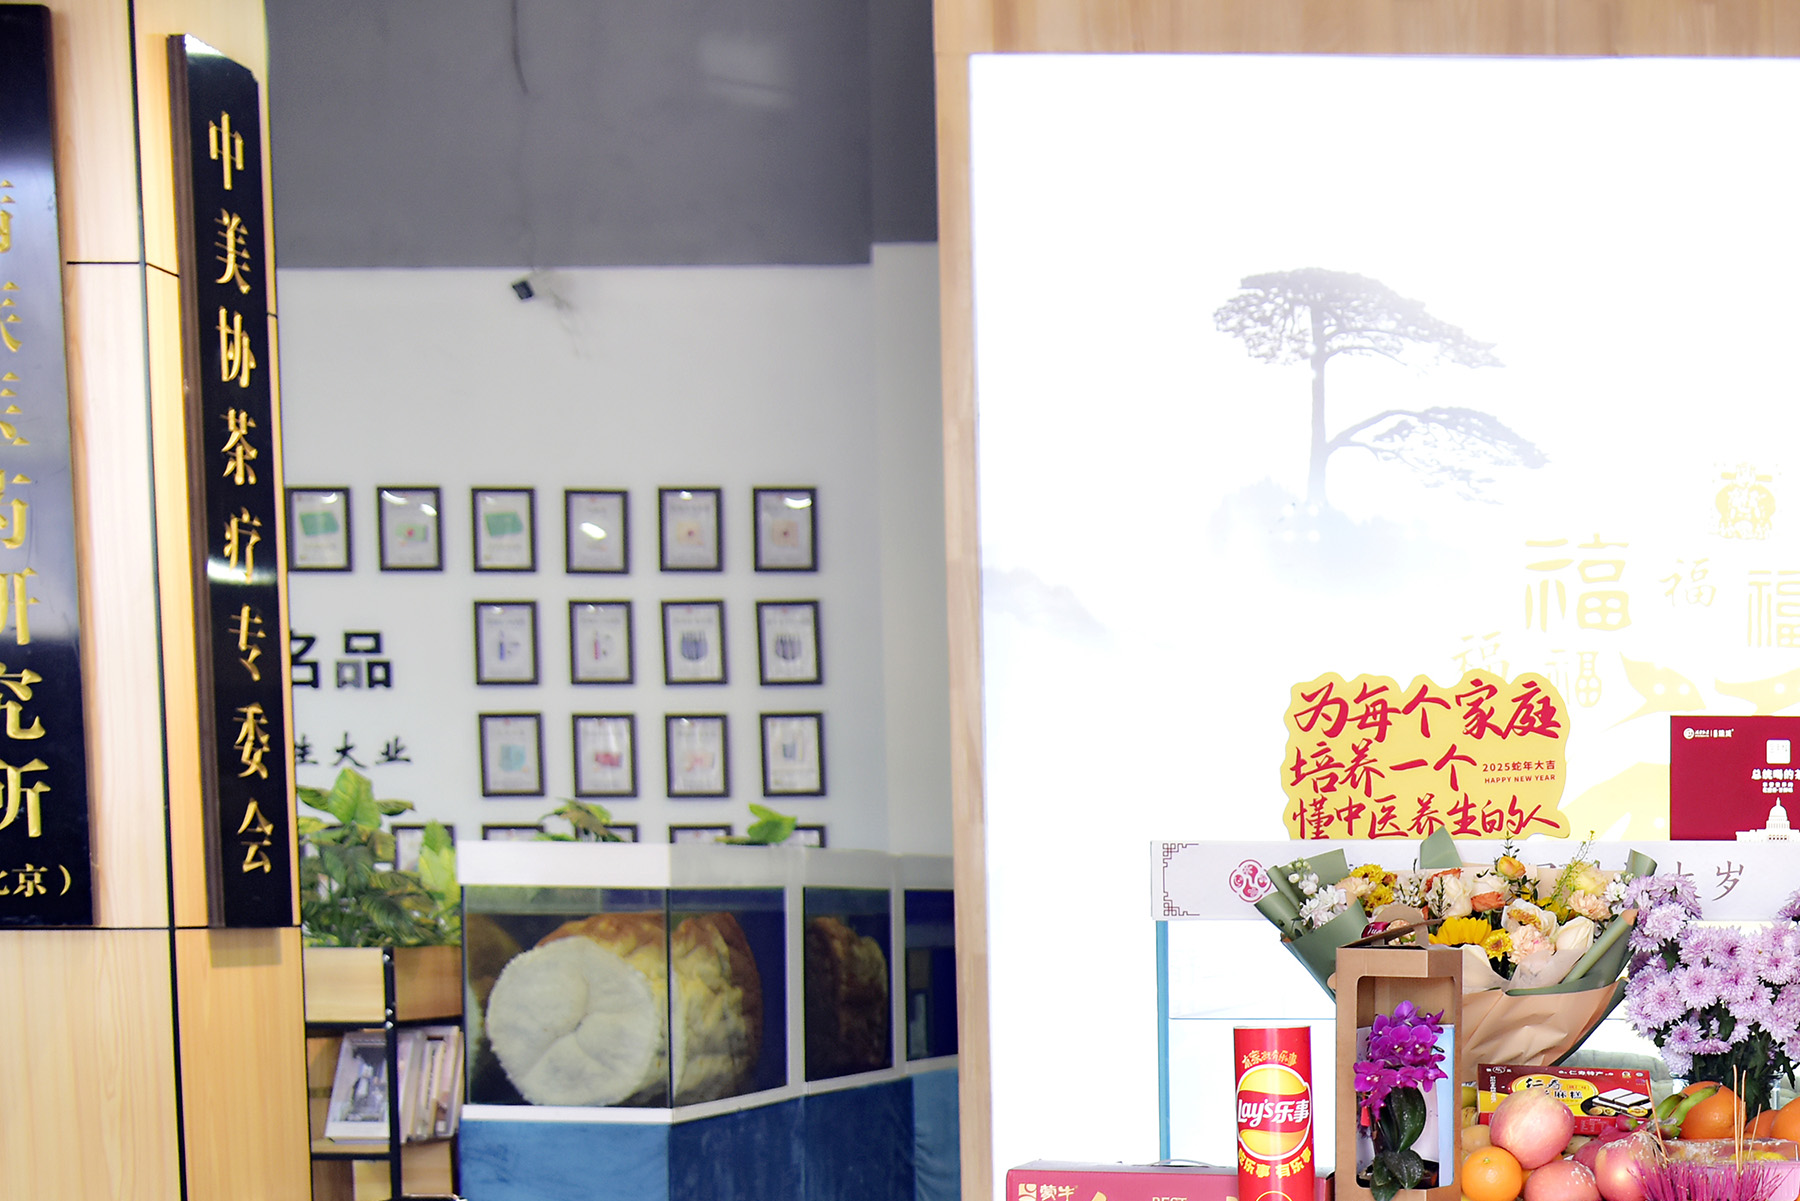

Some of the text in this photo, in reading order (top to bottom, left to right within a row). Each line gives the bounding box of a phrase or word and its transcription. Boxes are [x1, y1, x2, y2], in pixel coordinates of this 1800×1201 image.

[208, 110, 275, 876] 中美协茶疗专委会
[1524, 532, 1633, 633] 福
[1293, 678, 1562, 742] 为每个家庭
[1290, 738, 1478, 798] 培养一个
[1482, 759, 1556, 774] 2025蛇年大吉
[1484, 773, 1556, 784] HAPPY NEW YEAR
[1292, 792, 1561, 840] 懂中医养生的人
